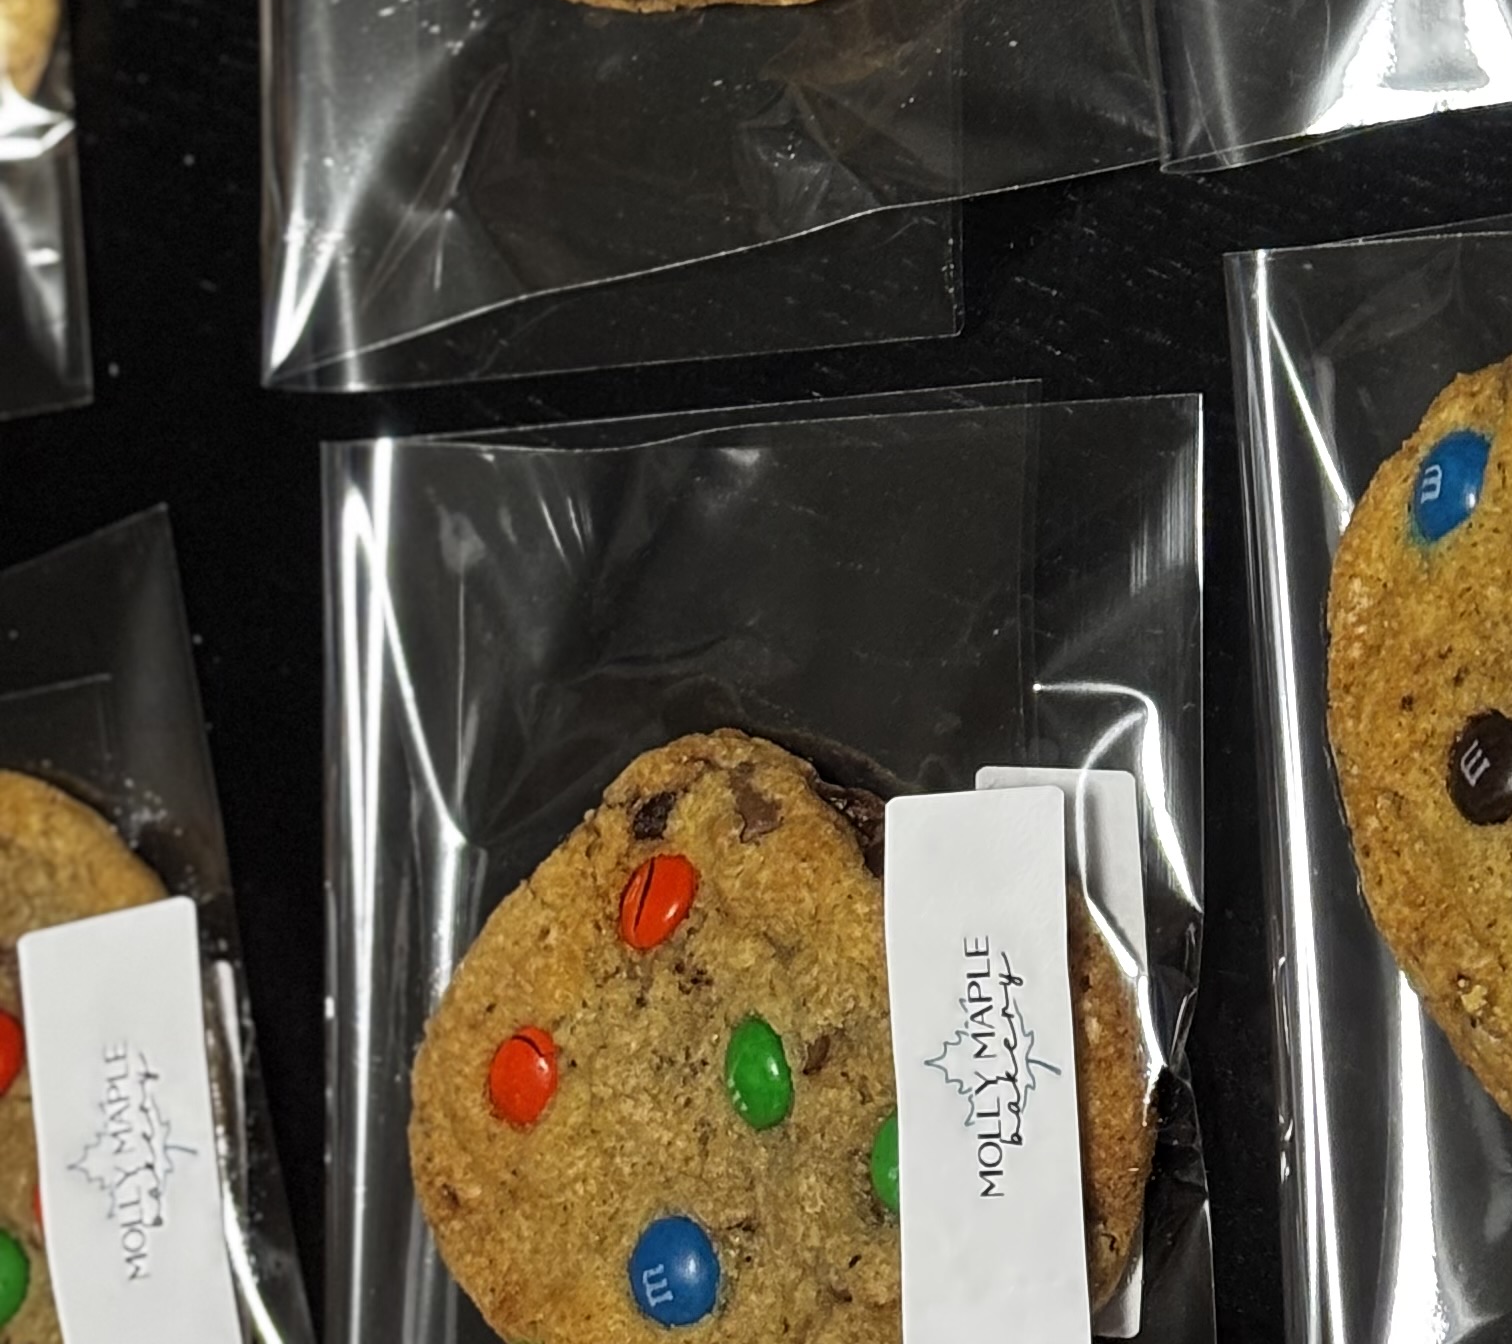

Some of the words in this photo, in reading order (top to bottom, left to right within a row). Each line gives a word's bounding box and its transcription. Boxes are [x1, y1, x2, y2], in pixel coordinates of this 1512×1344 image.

[1421, 465, 1442, 503] m
[1461, 739, 1490, 786] m
[963, 935, 996, 1059] MAPLE
[996, 951, 1023, 1146] bakery
[102, 1040, 133, 1155] MAPLE
[971, 1071, 1004, 1197] MOLLY
[115, 1166, 151, 1281] MOLLY
[643, 1264, 673, 1306] m
